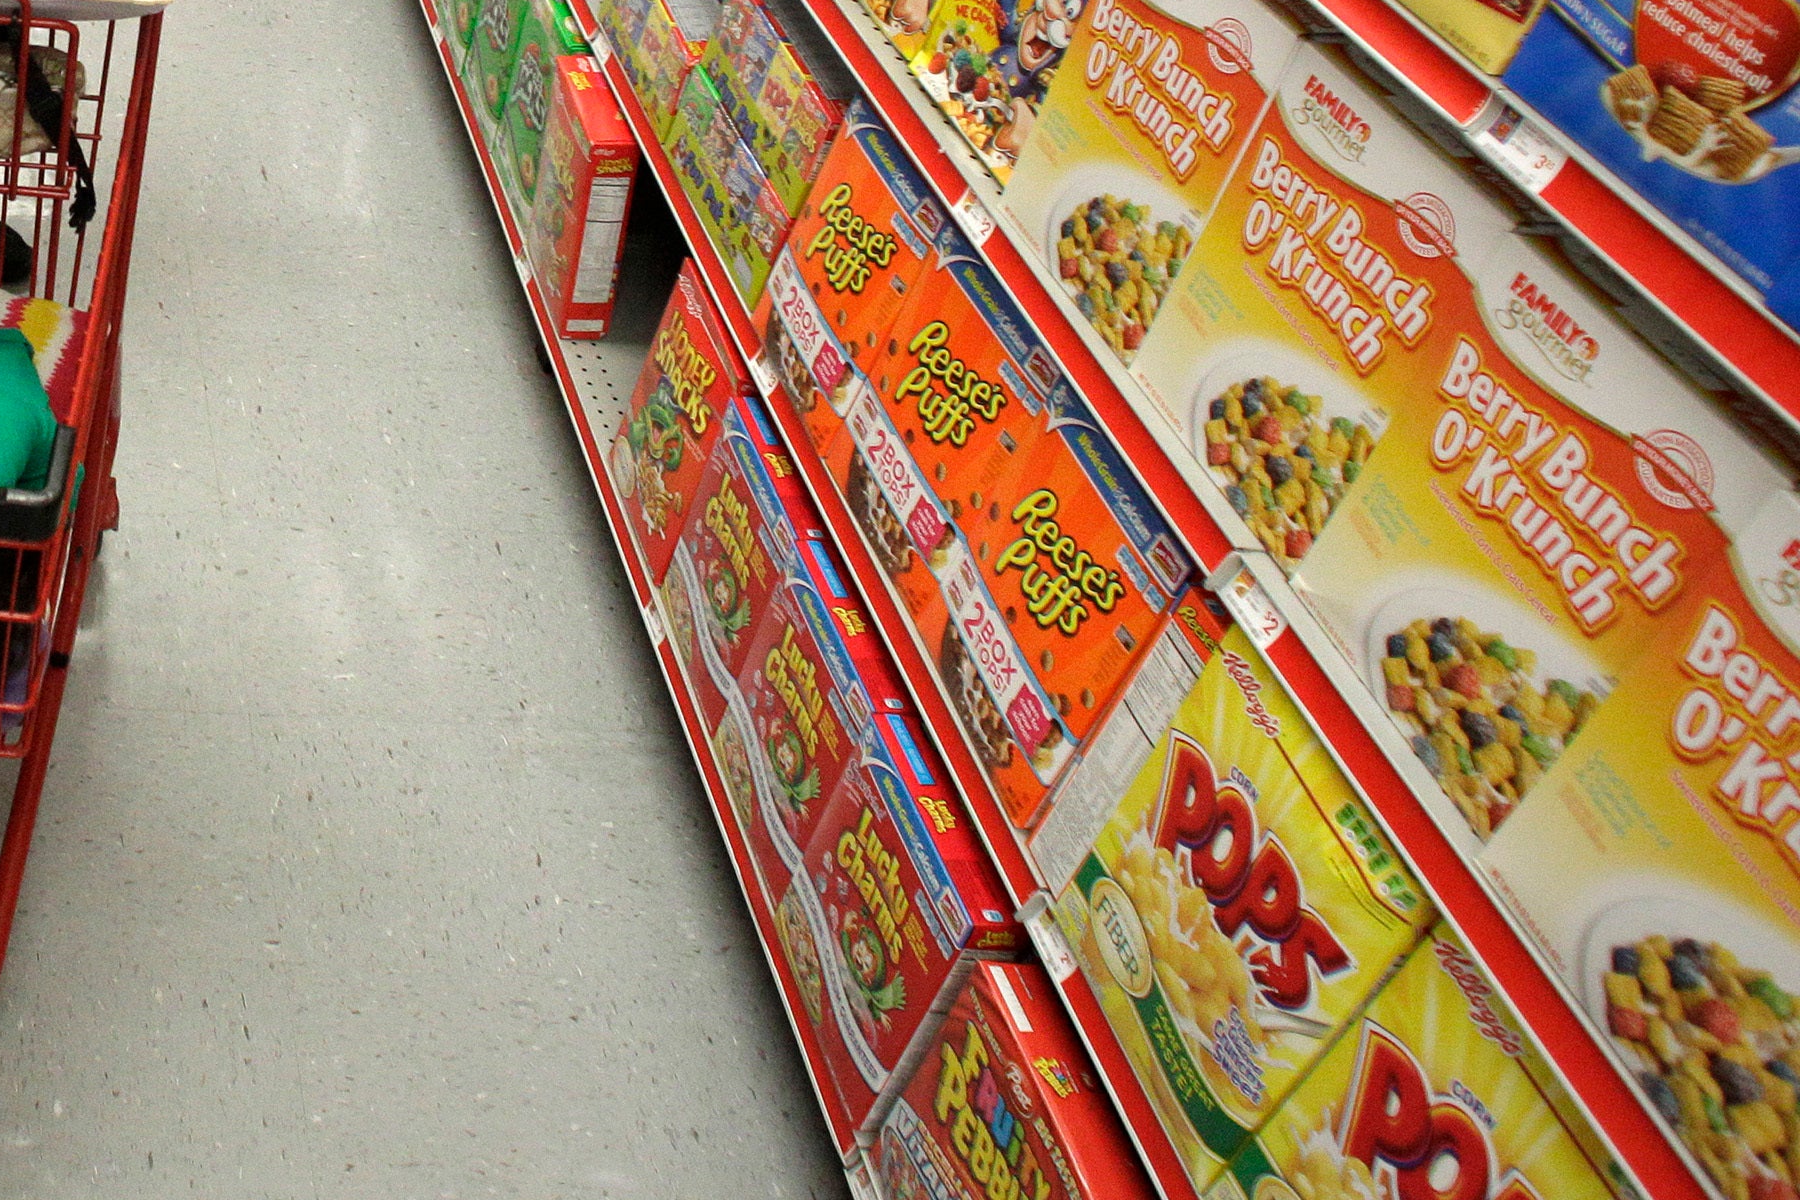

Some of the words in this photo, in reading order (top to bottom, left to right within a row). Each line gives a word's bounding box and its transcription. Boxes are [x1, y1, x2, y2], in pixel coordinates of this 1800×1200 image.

[1106, 64, 1200, 181] Krunch
[1155, 40, 1237, 150] Bunch
[805, 225, 874, 294] Puffs
[818, 183, 898, 269] Reese's
[1248, 134, 1335, 237] Berry
[1327, 207, 1434, 342] Bunch
[1272, 230, 1385, 370] Krunch
[897, 365, 977, 447] Puffs
[908, 319, 1008, 420] Reese's
[1440, 339, 1557, 462] Berry
[1545, 426, 1682, 603] Bunch
[996, 537, 1091, 636] Puffs
[1012, 489, 1125, 613] Reese's
[1463, 454, 1623, 633] Krunch
[1222, 652, 1283, 739] Kellogg's
[836, 831, 905, 963] Charms
[858, 806, 910, 925] Lucky
[1433, 939, 1523, 1058] Kellogg's
